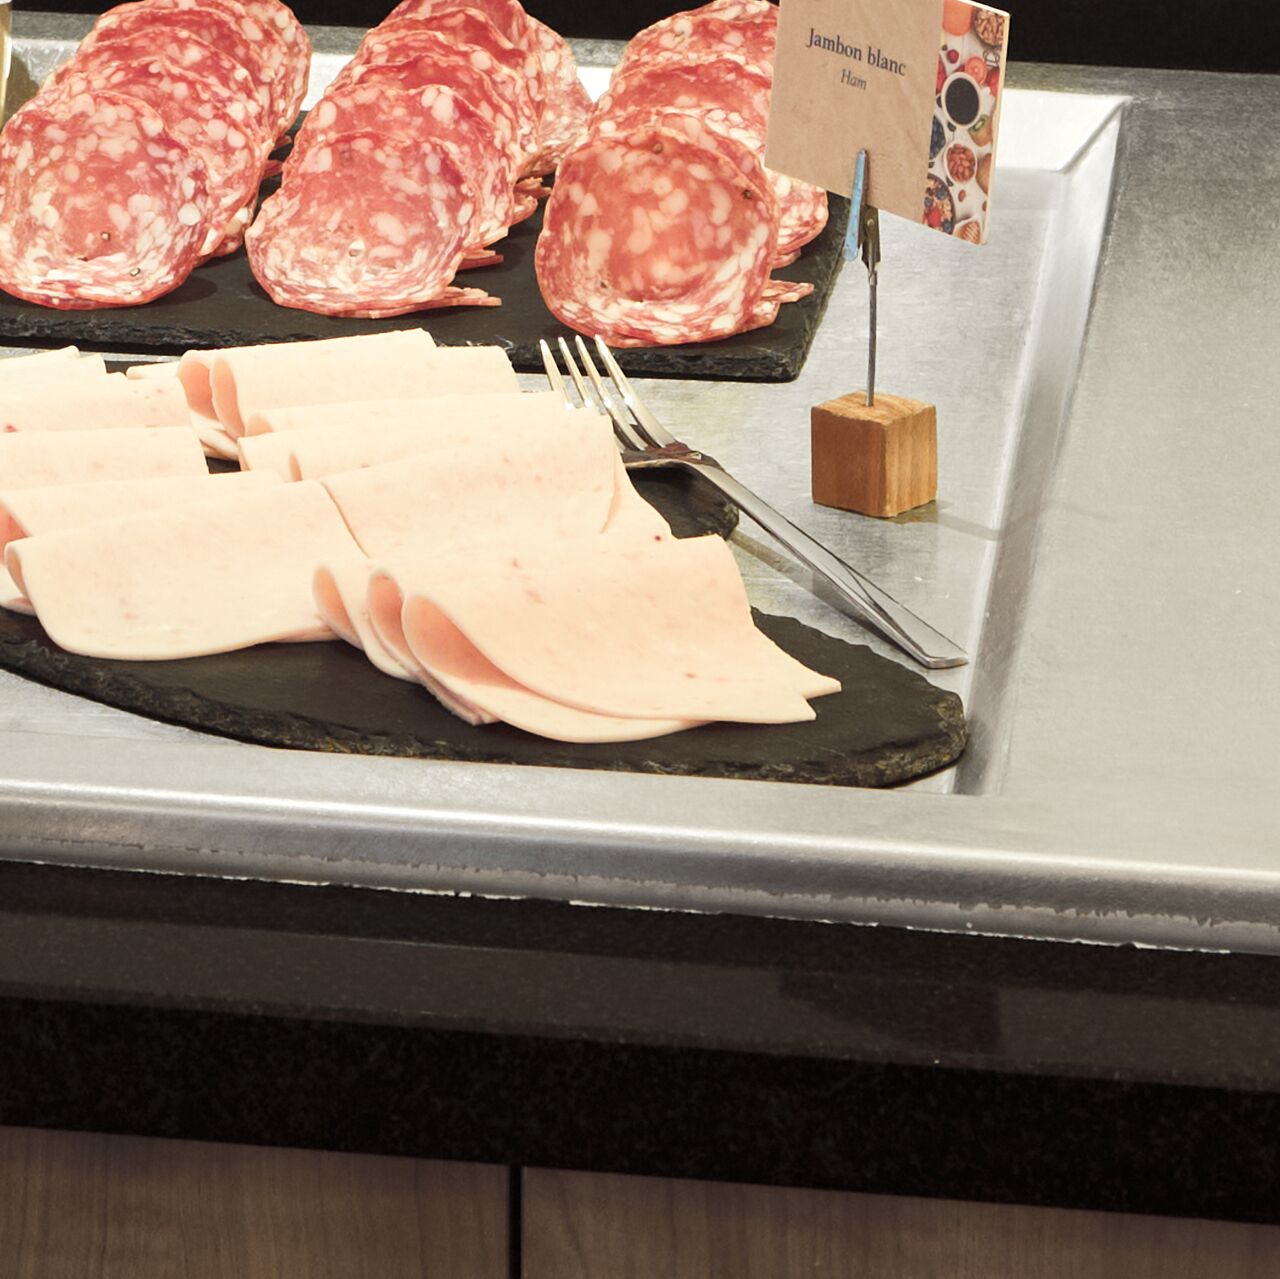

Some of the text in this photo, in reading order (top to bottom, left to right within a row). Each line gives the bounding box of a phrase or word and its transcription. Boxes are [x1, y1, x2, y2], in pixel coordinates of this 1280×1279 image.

[805, 27, 907, 76] Jambon blanc
[840, 68, 867, 91] Ham
